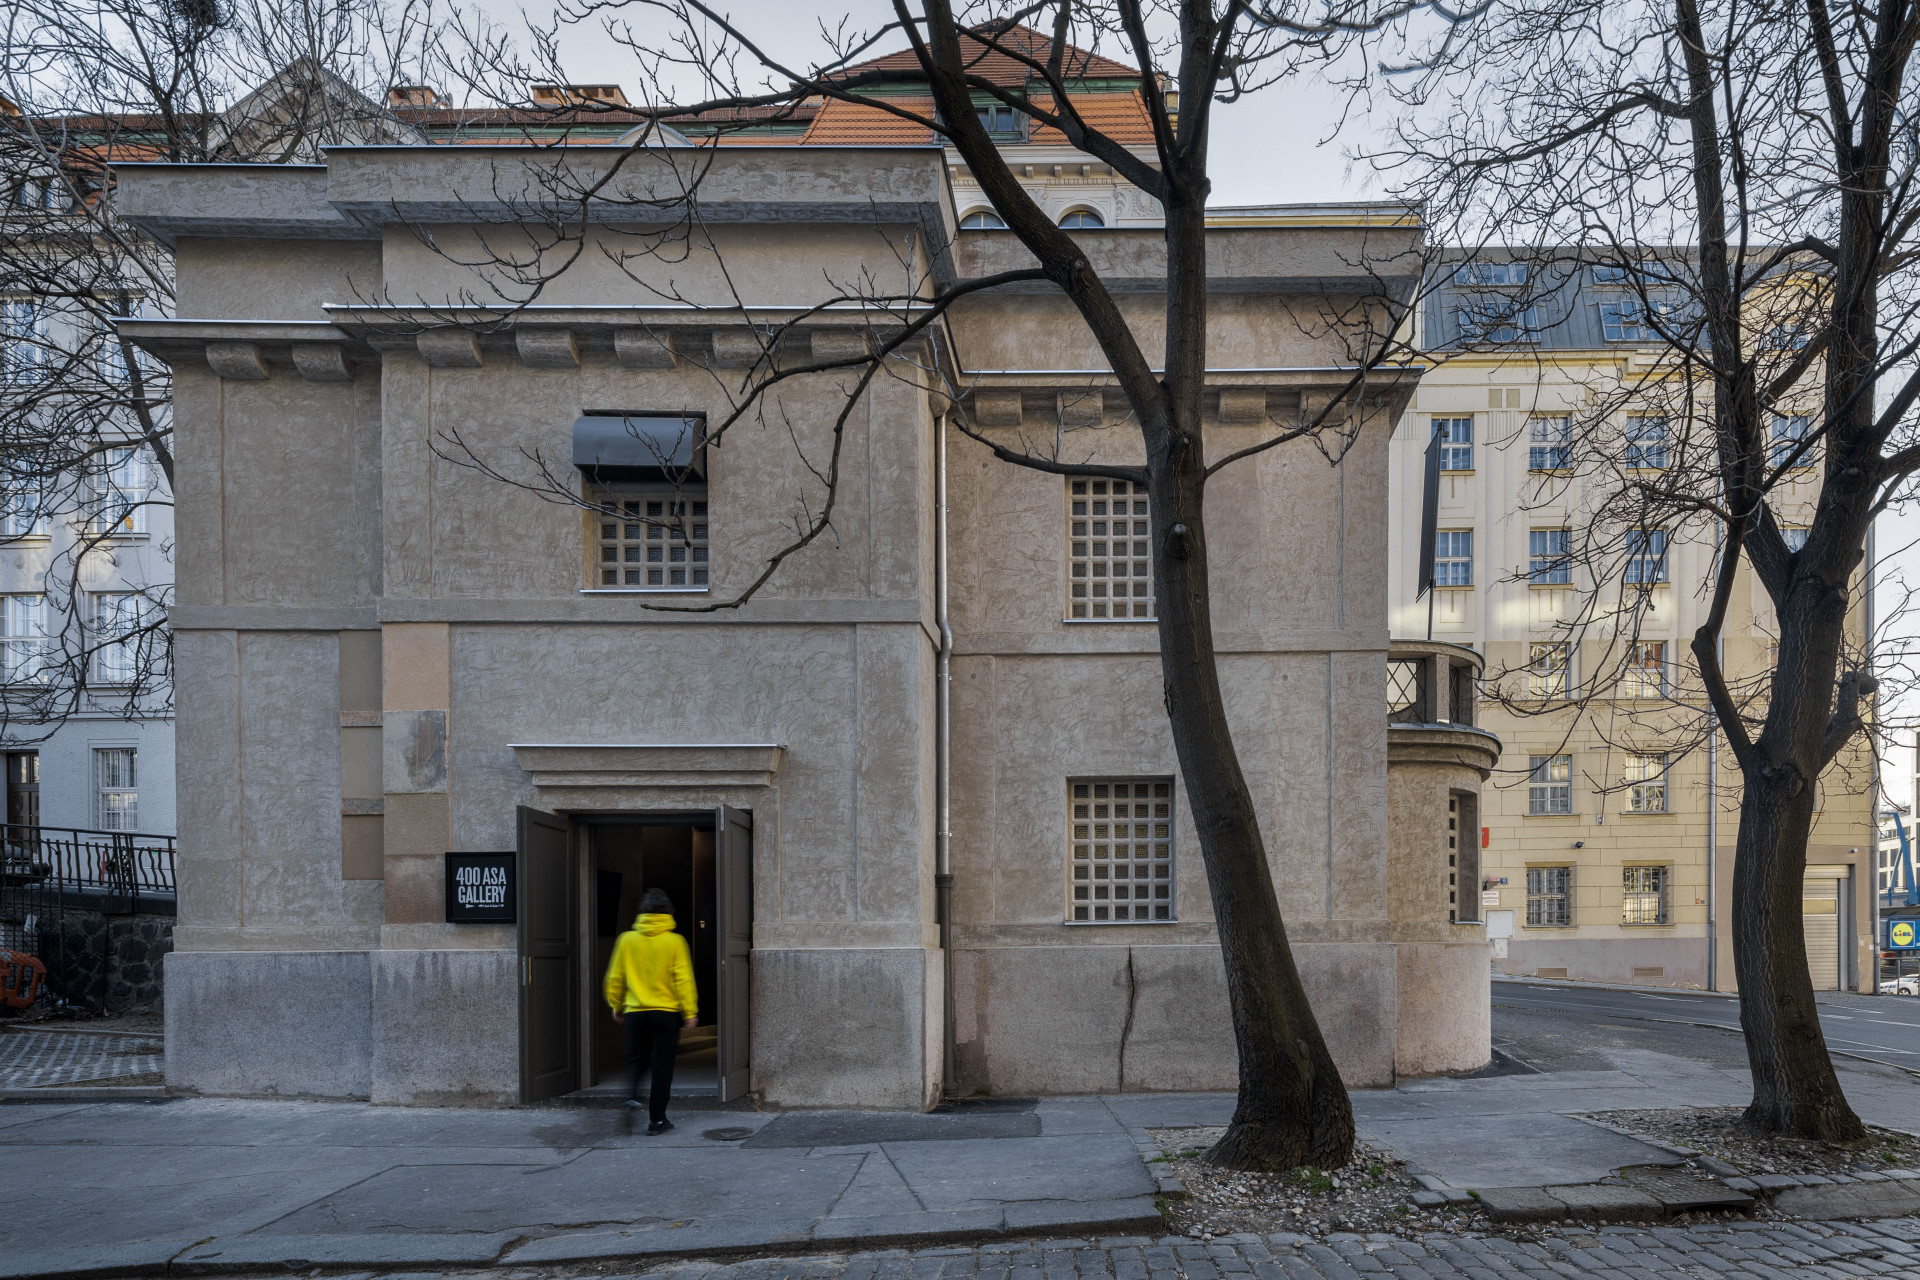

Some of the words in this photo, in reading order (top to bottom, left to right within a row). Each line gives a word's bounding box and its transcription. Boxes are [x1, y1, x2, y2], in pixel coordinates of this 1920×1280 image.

[456, 867, 480, 885] 400
[482, 867, 507, 885] ASA
[458, 886, 506, 903] GALLERY
